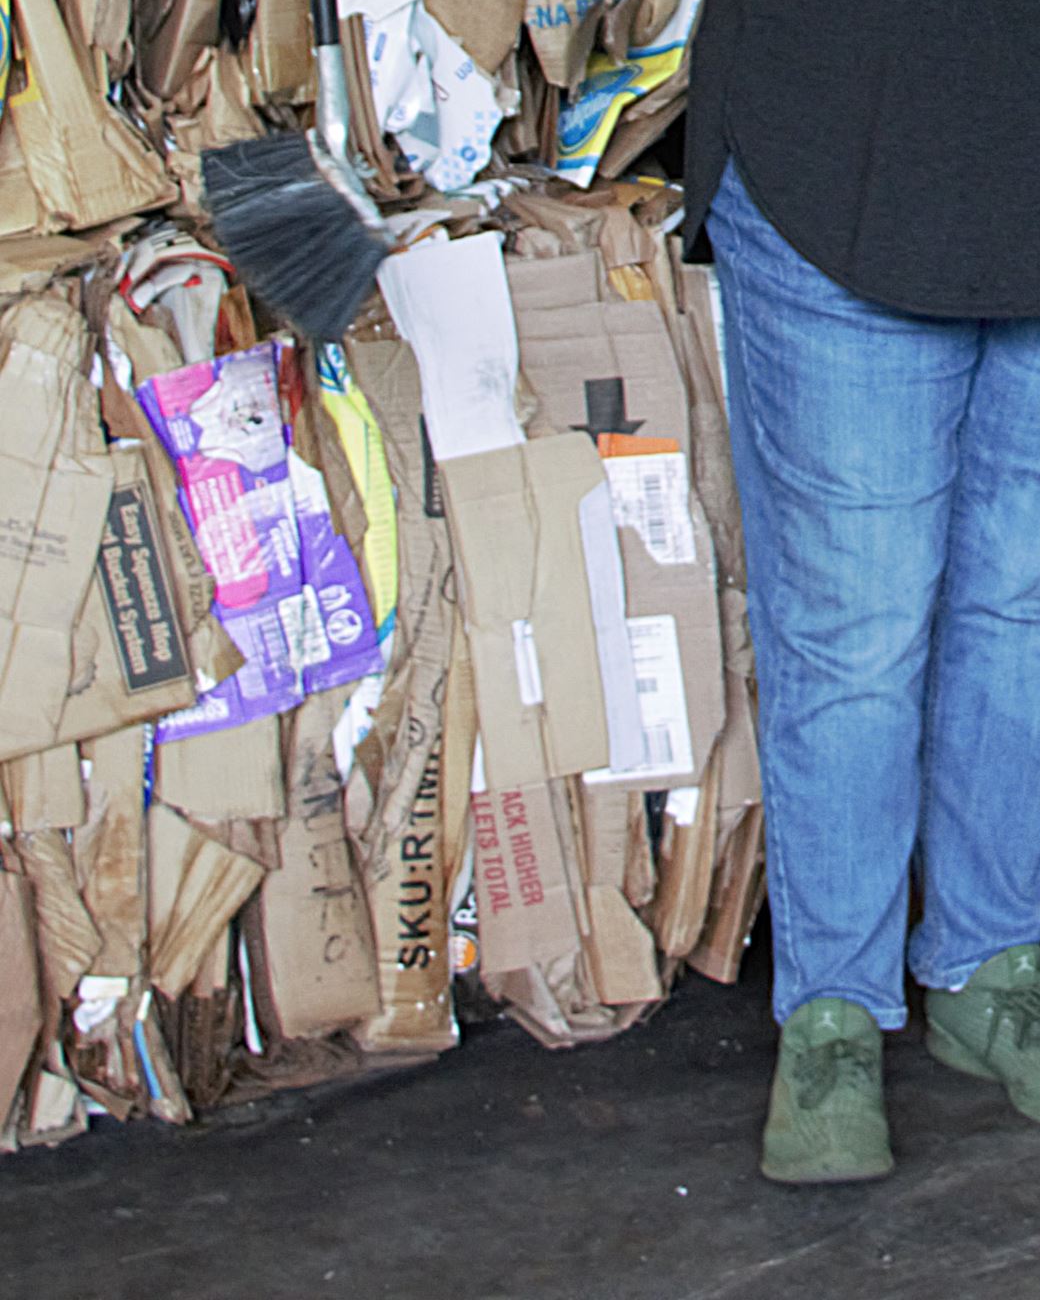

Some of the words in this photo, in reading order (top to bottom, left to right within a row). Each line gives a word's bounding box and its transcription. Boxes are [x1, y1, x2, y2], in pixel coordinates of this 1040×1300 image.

[120, 502, 143, 545] Easy
[103, 545, 134, 609] Bucket
[131, 546, 162, 621] Squeeze
[118, 608, 148, 676] System
[150, 621, 172, 662] Mop
[501, 789, 526, 829] ACK
[481, 856, 513, 915] TOTAL
[508, 831, 546, 907] HIGHER
